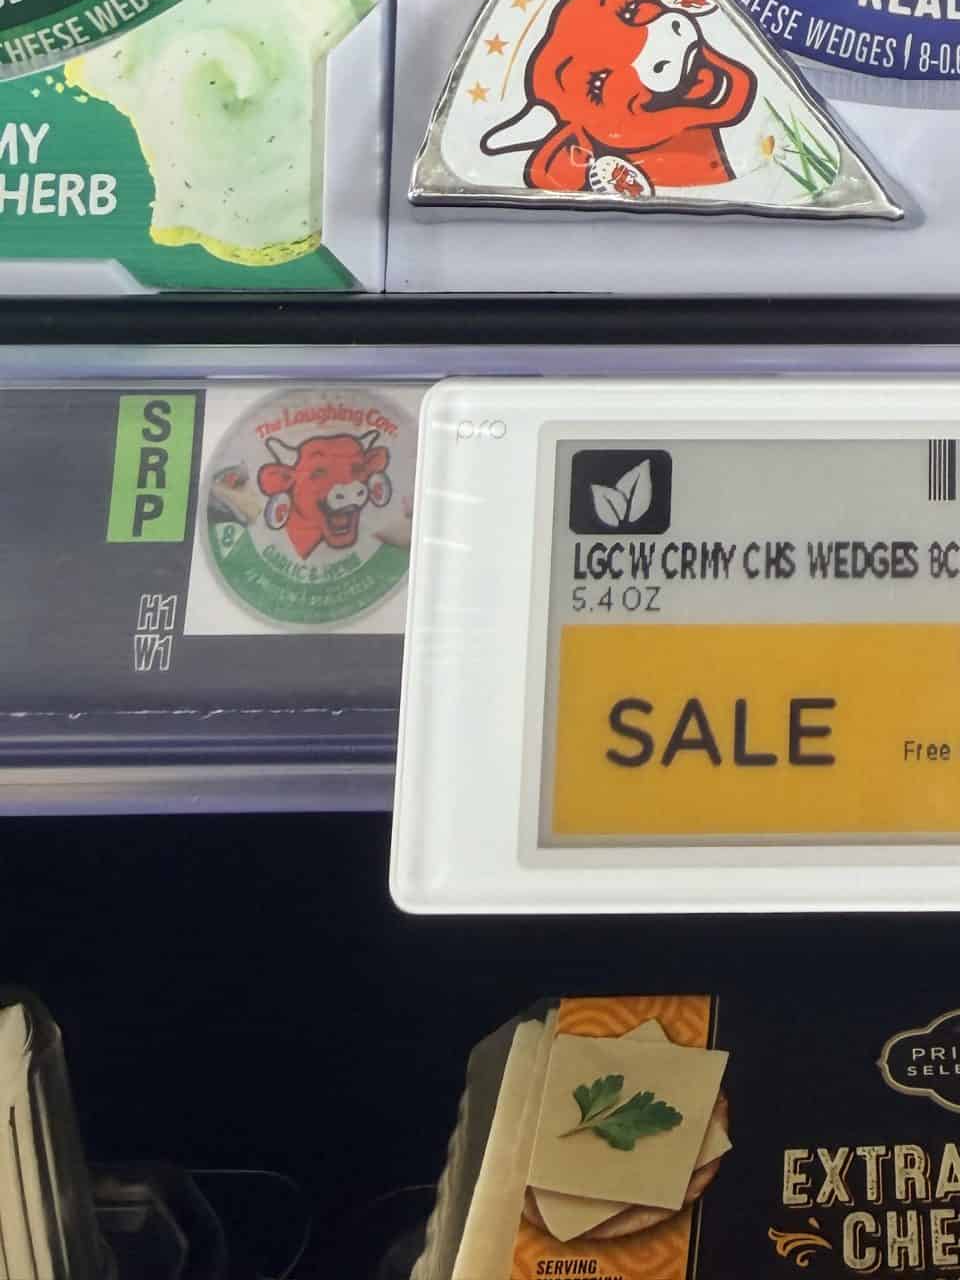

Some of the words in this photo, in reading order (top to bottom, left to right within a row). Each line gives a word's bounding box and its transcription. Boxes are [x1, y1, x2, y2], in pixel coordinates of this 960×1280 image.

[0, 17, 90, 64] HEESE
[805, 17, 897, 68] WEDGES
[573, 541, 656, 580] LGCW
[661, 541, 737, 580] CRMY
[743, 541, 796, 580] CHS
[807, 540, 919, 580] WEDGES
[136, 594, 178, 630] H1
[134, 635, 173, 672] W1
[605, 697, 837, 769] SALE
[903, 740, 951, 761] Free
[536, 1259, 597, 1275] SERVING
